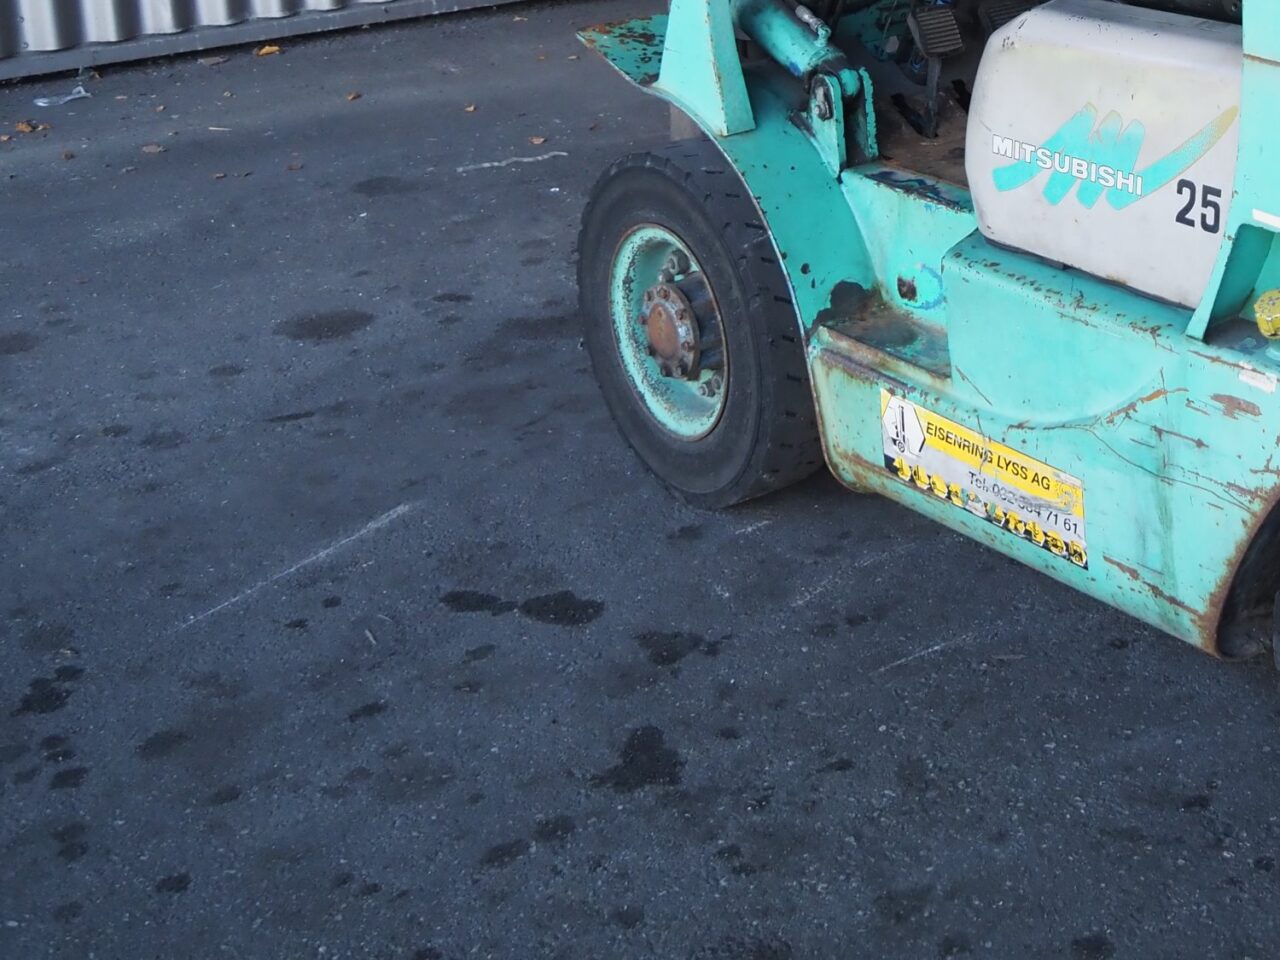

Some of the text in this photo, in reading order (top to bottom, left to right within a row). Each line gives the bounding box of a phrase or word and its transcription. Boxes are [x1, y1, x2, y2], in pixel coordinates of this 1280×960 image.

[992, 134, 1144, 196] MITSUBISHI
[1175, 178, 1223, 234] 25
[926, 422, 1051, 491] EISENRING LYSS AG
[1063, 518, 1078, 534] 61
